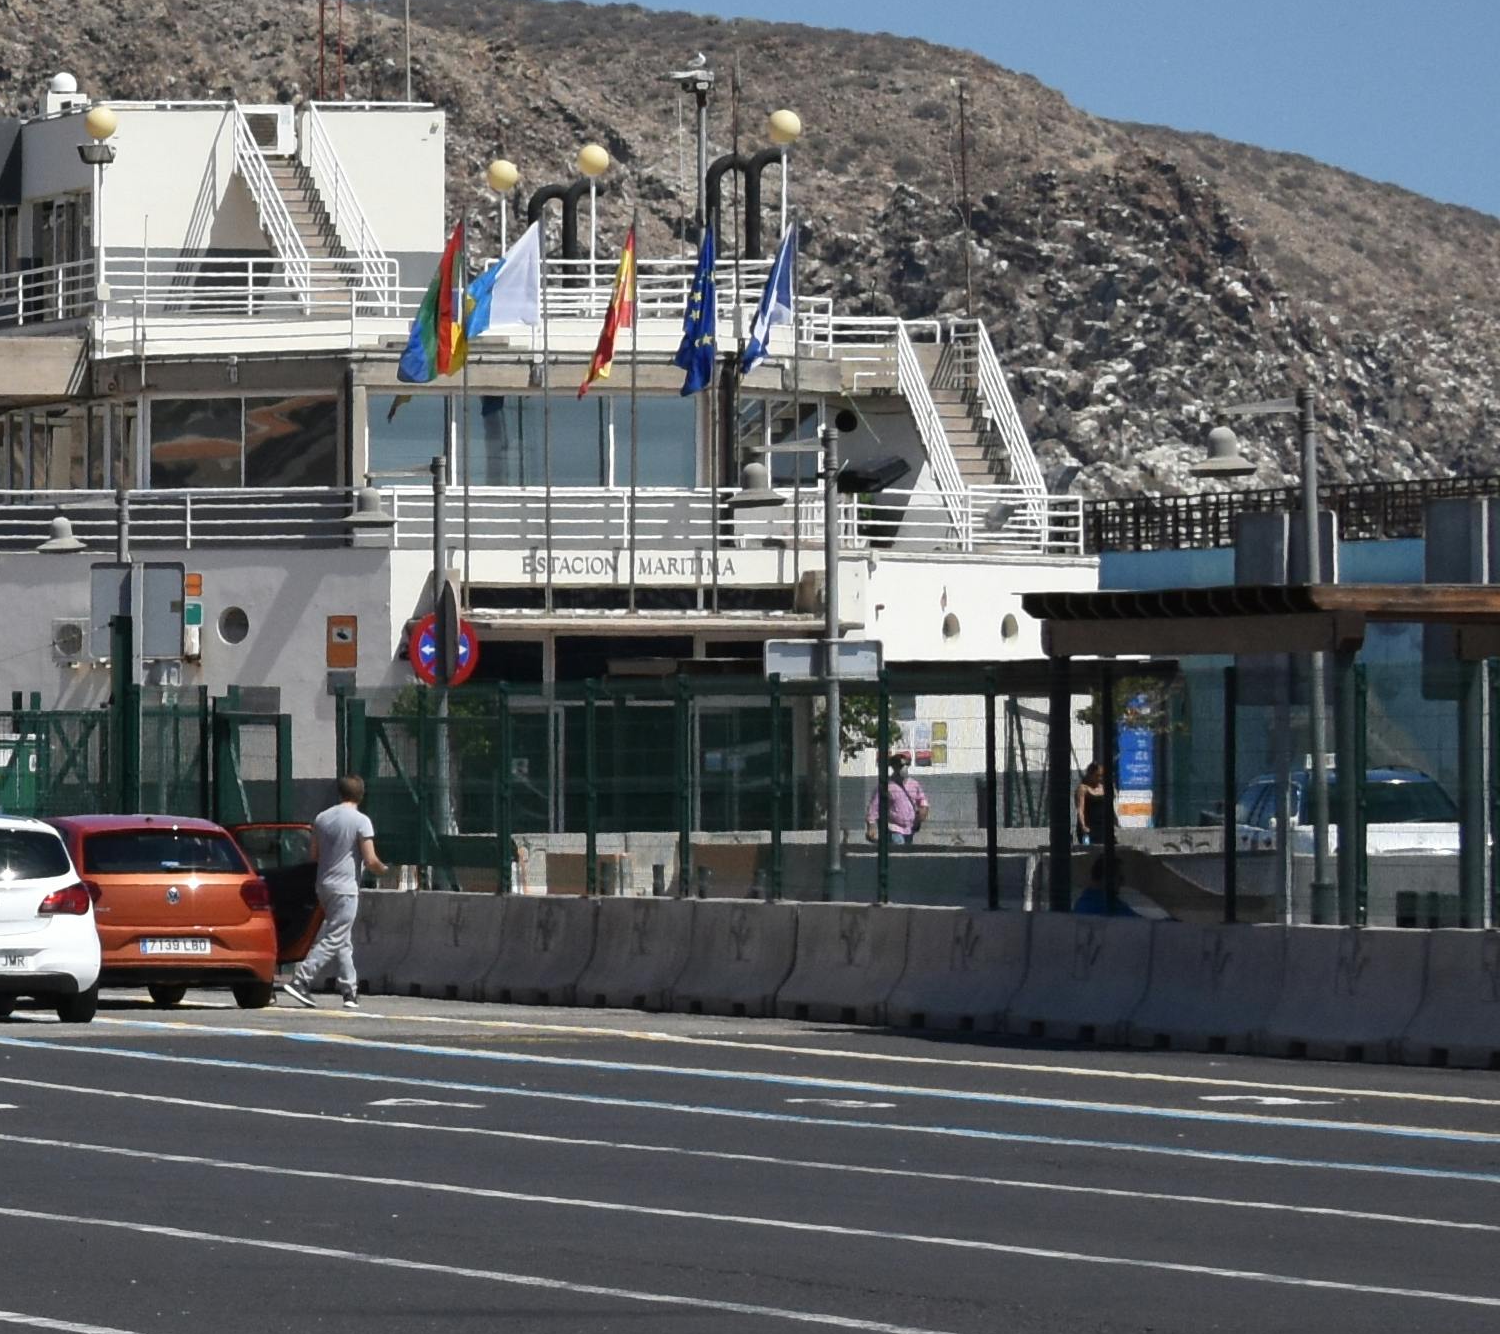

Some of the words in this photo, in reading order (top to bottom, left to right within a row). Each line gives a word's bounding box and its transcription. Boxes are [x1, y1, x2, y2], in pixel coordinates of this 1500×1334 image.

[522, 555, 619, 575] ESTACION
[638, 556, 736, 576] MARITIMA
[149, 939, 180, 951] 7139
